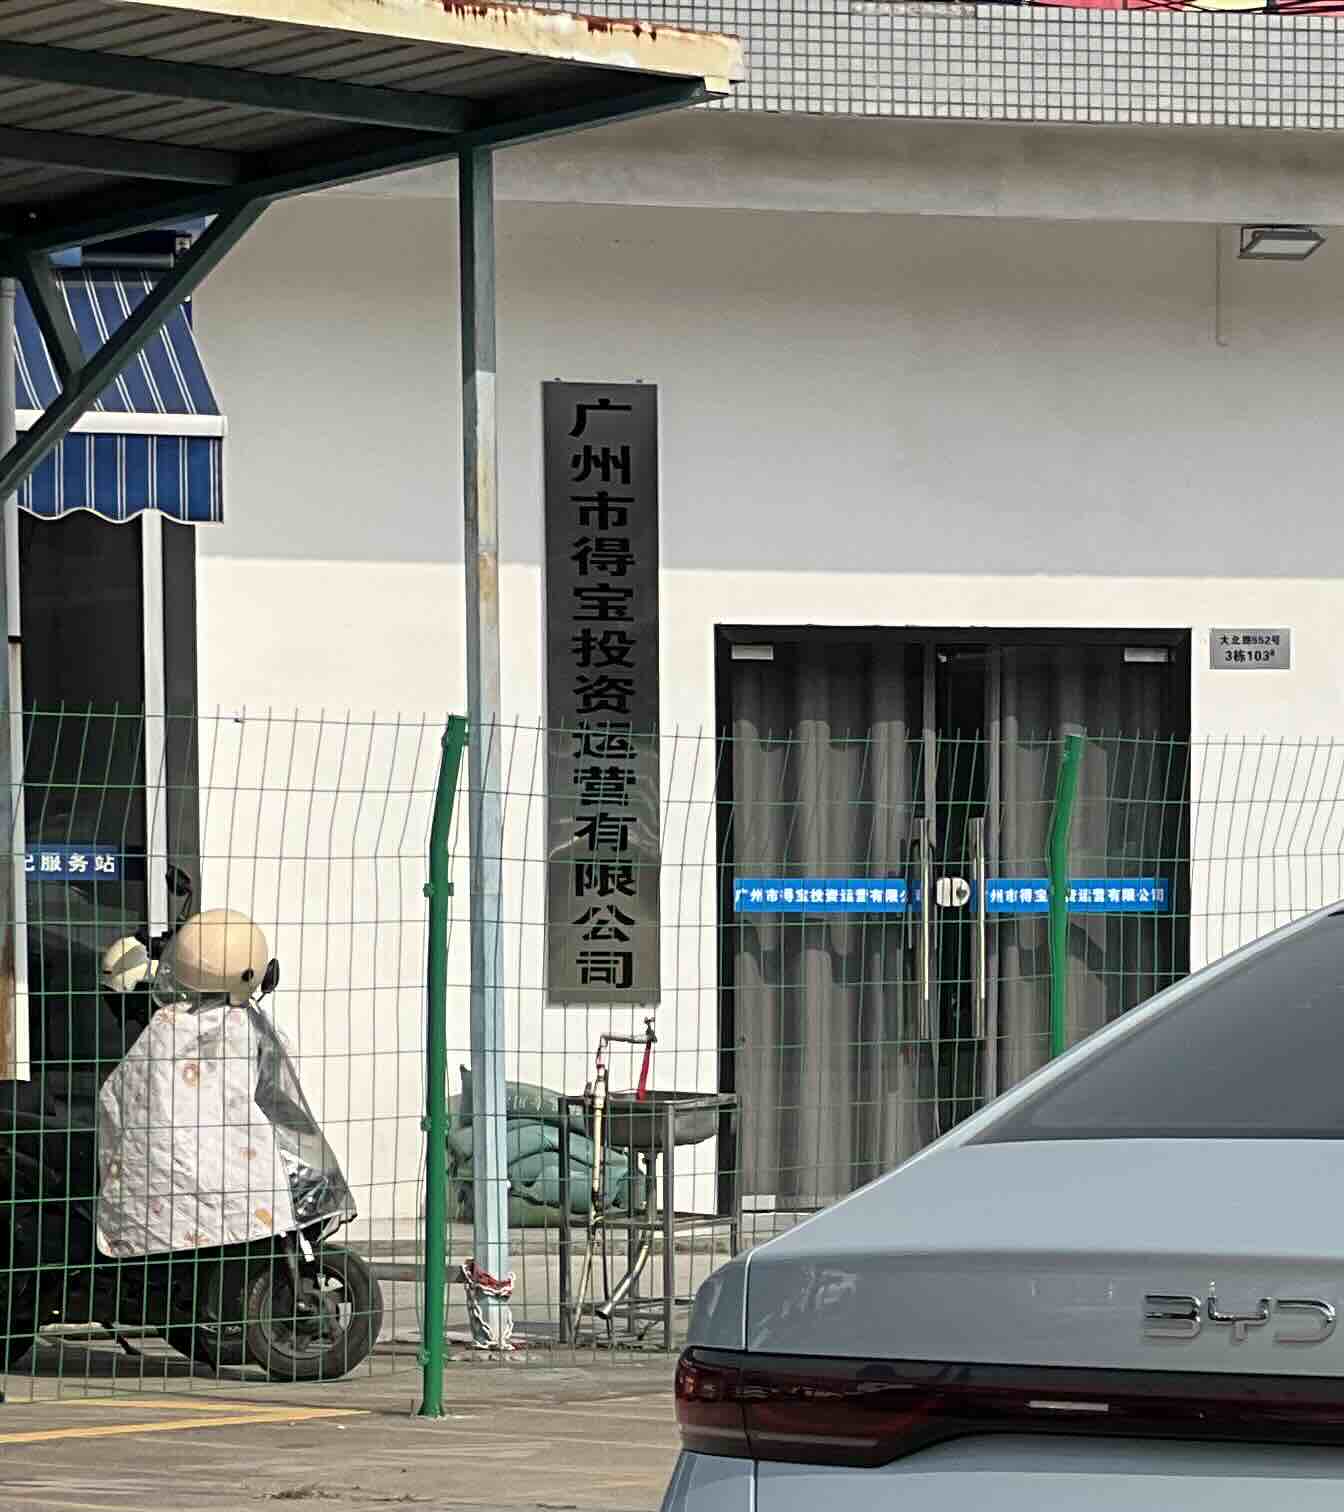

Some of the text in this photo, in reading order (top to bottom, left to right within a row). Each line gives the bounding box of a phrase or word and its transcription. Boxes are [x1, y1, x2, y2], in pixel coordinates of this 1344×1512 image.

[569, 398, 637, 990] 广州市得宝投资运营有限公司
[1144, 1281, 1337, 1343] BYD
